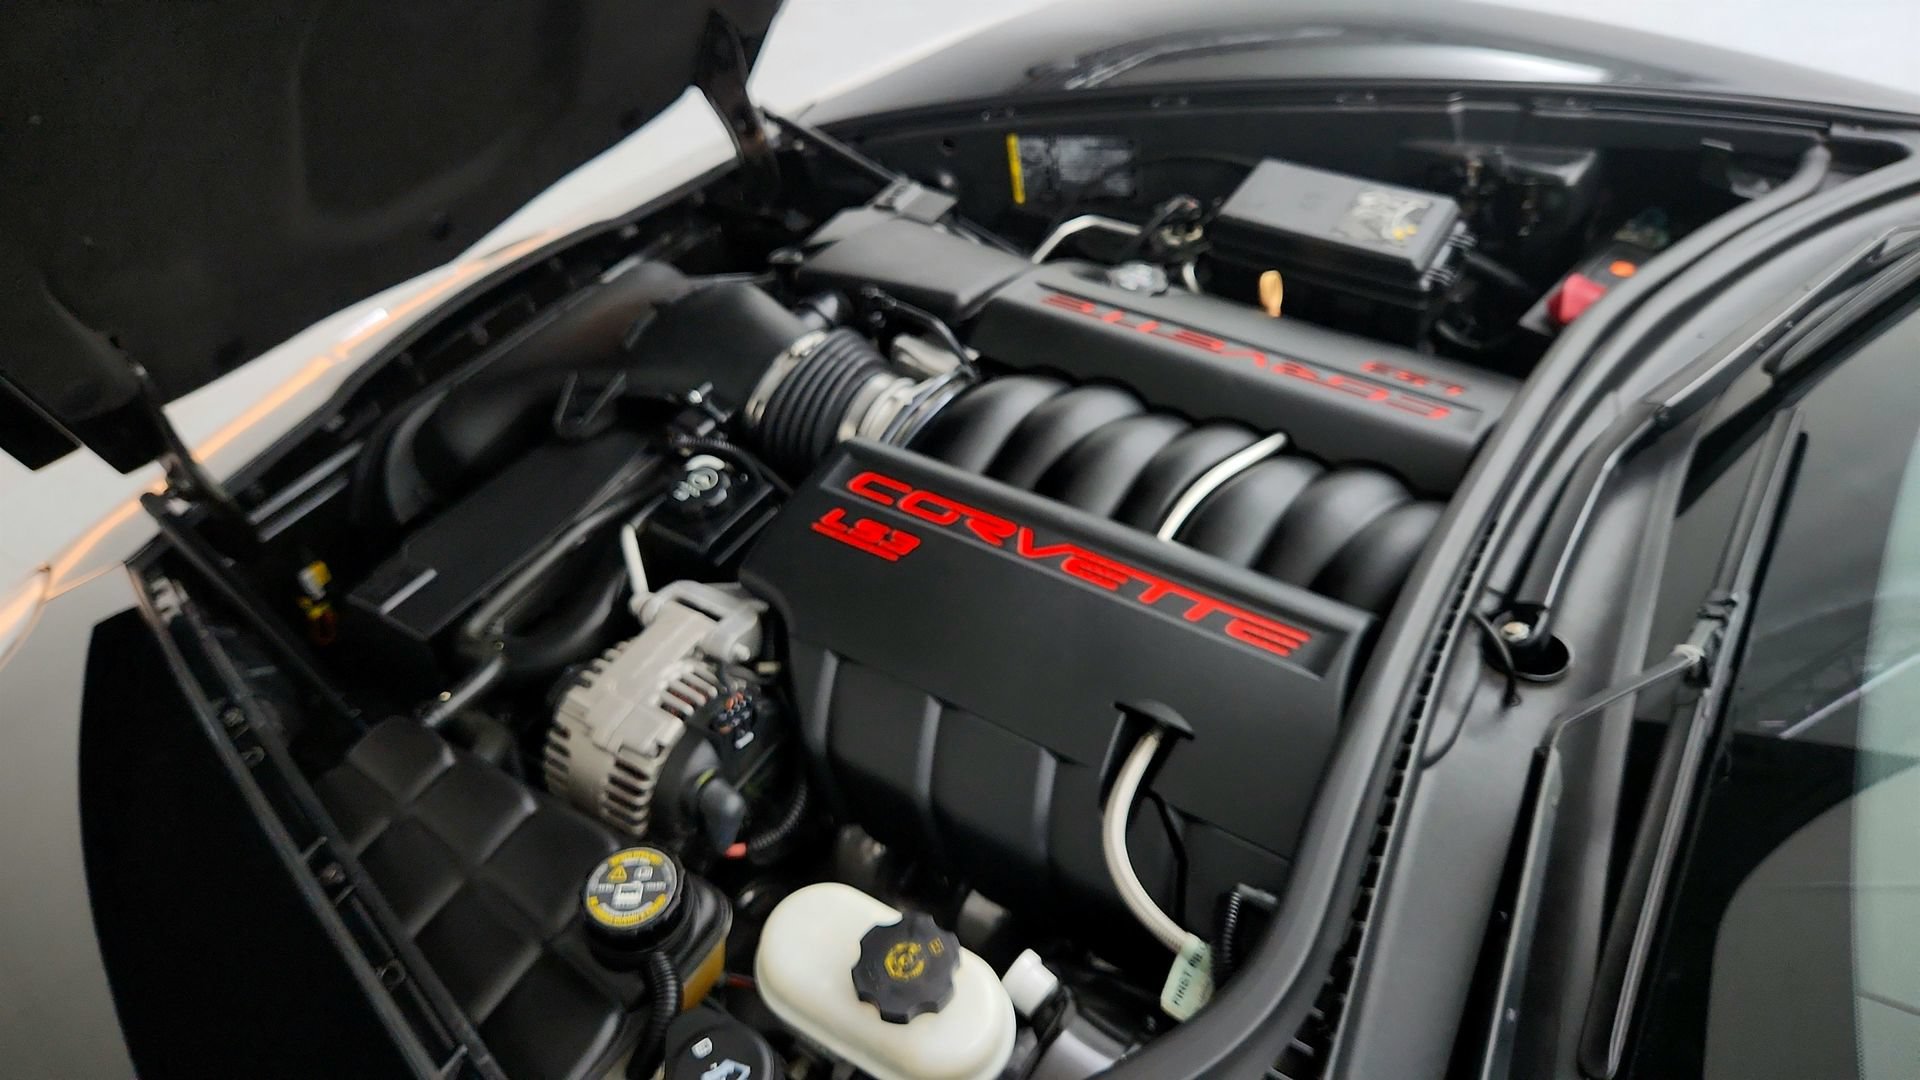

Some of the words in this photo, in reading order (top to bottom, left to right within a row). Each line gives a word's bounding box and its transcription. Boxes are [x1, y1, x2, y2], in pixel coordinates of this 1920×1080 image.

[1045, 295, 1451, 420] CORVETTE
[811, 507, 922, 562] LS3
[844, 471, 1311, 656] CORVETTE
